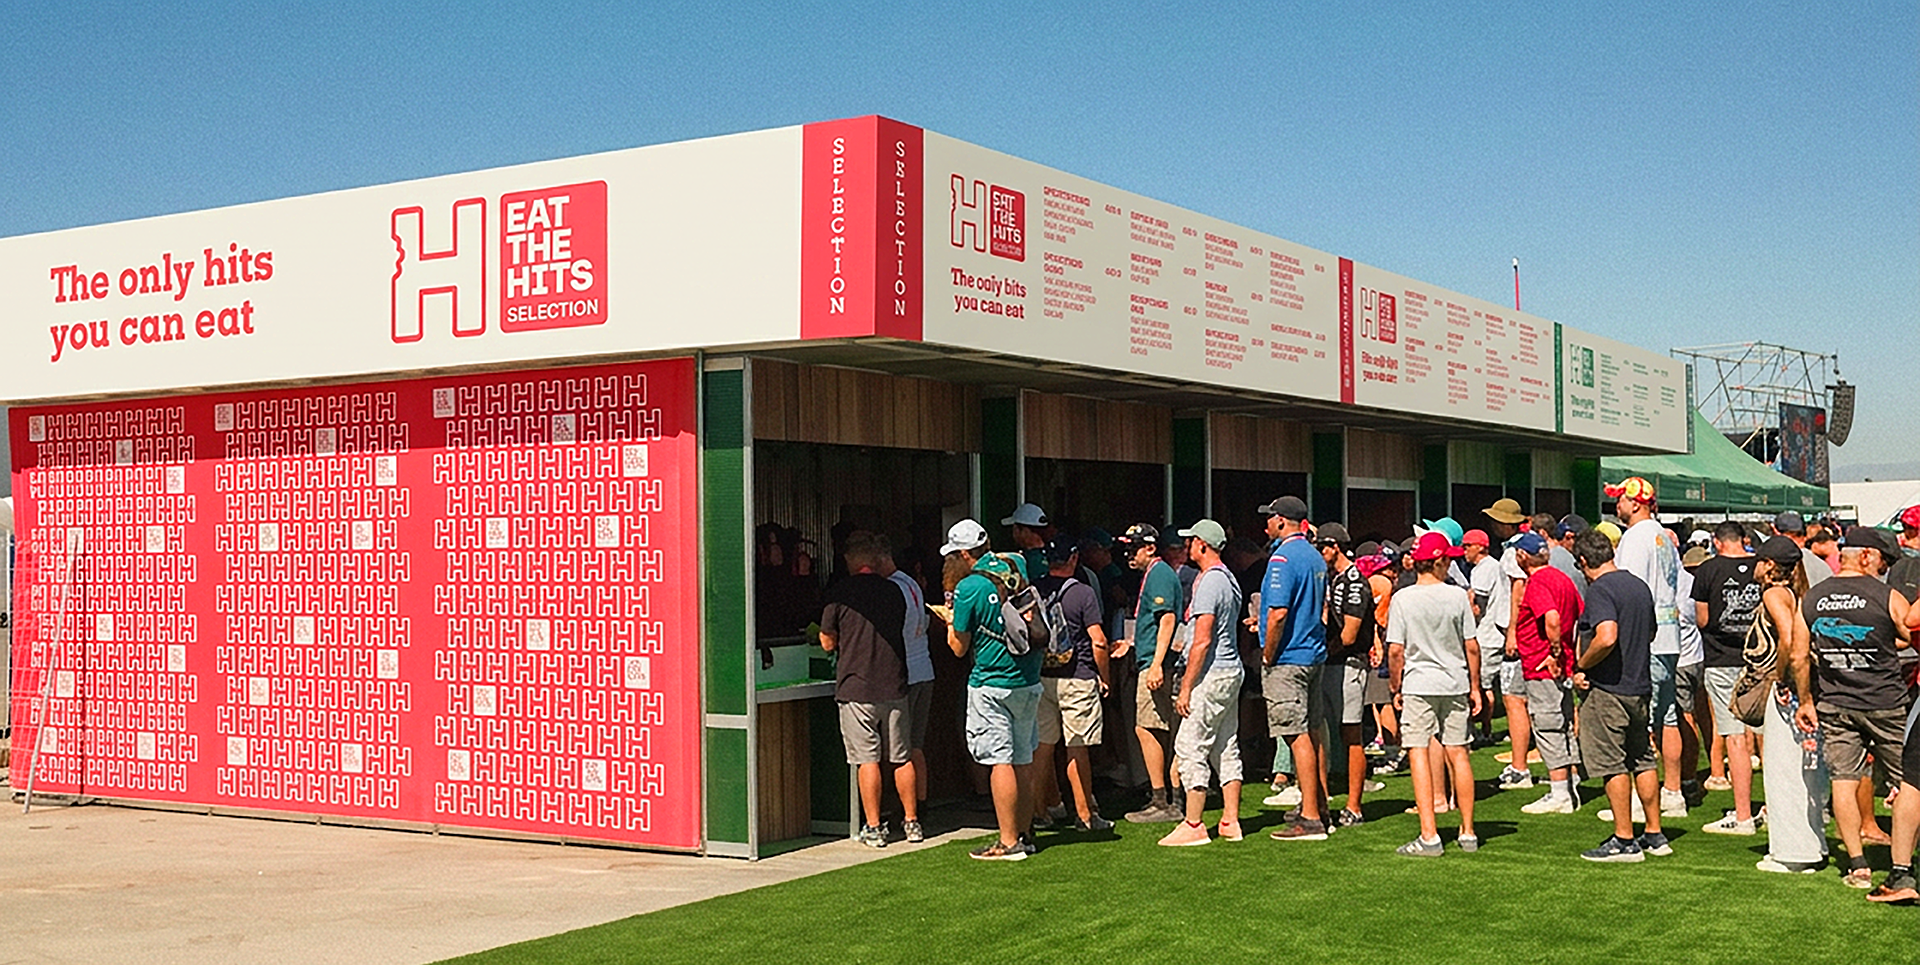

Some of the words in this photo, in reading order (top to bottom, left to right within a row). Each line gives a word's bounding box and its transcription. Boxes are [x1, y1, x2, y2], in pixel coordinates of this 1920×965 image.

[507, 196, 570, 232] EAT
[830, 138, 845, 313] SELECTION
[895, 141, 906, 315] SELECTION
[506, 228, 571, 265] THE
[50, 265, 109, 304] The
[119, 253, 194, 301] only
[204, 241, 273, 292] hits
[391, 197, 486, 344] H
[507, 260, 594, 299] HITS
[951, 268, 975, 288] The
[507, 299, 598, 322] SELECTION
[954, 295, 978, 313] you
[980, 300, 1003, 316] can
[1005, 303, 1025, 320] eat
[50, 318, 109, 362] you
[120, 314, 185, 345] can
[195, 300, 254, 338] eat
